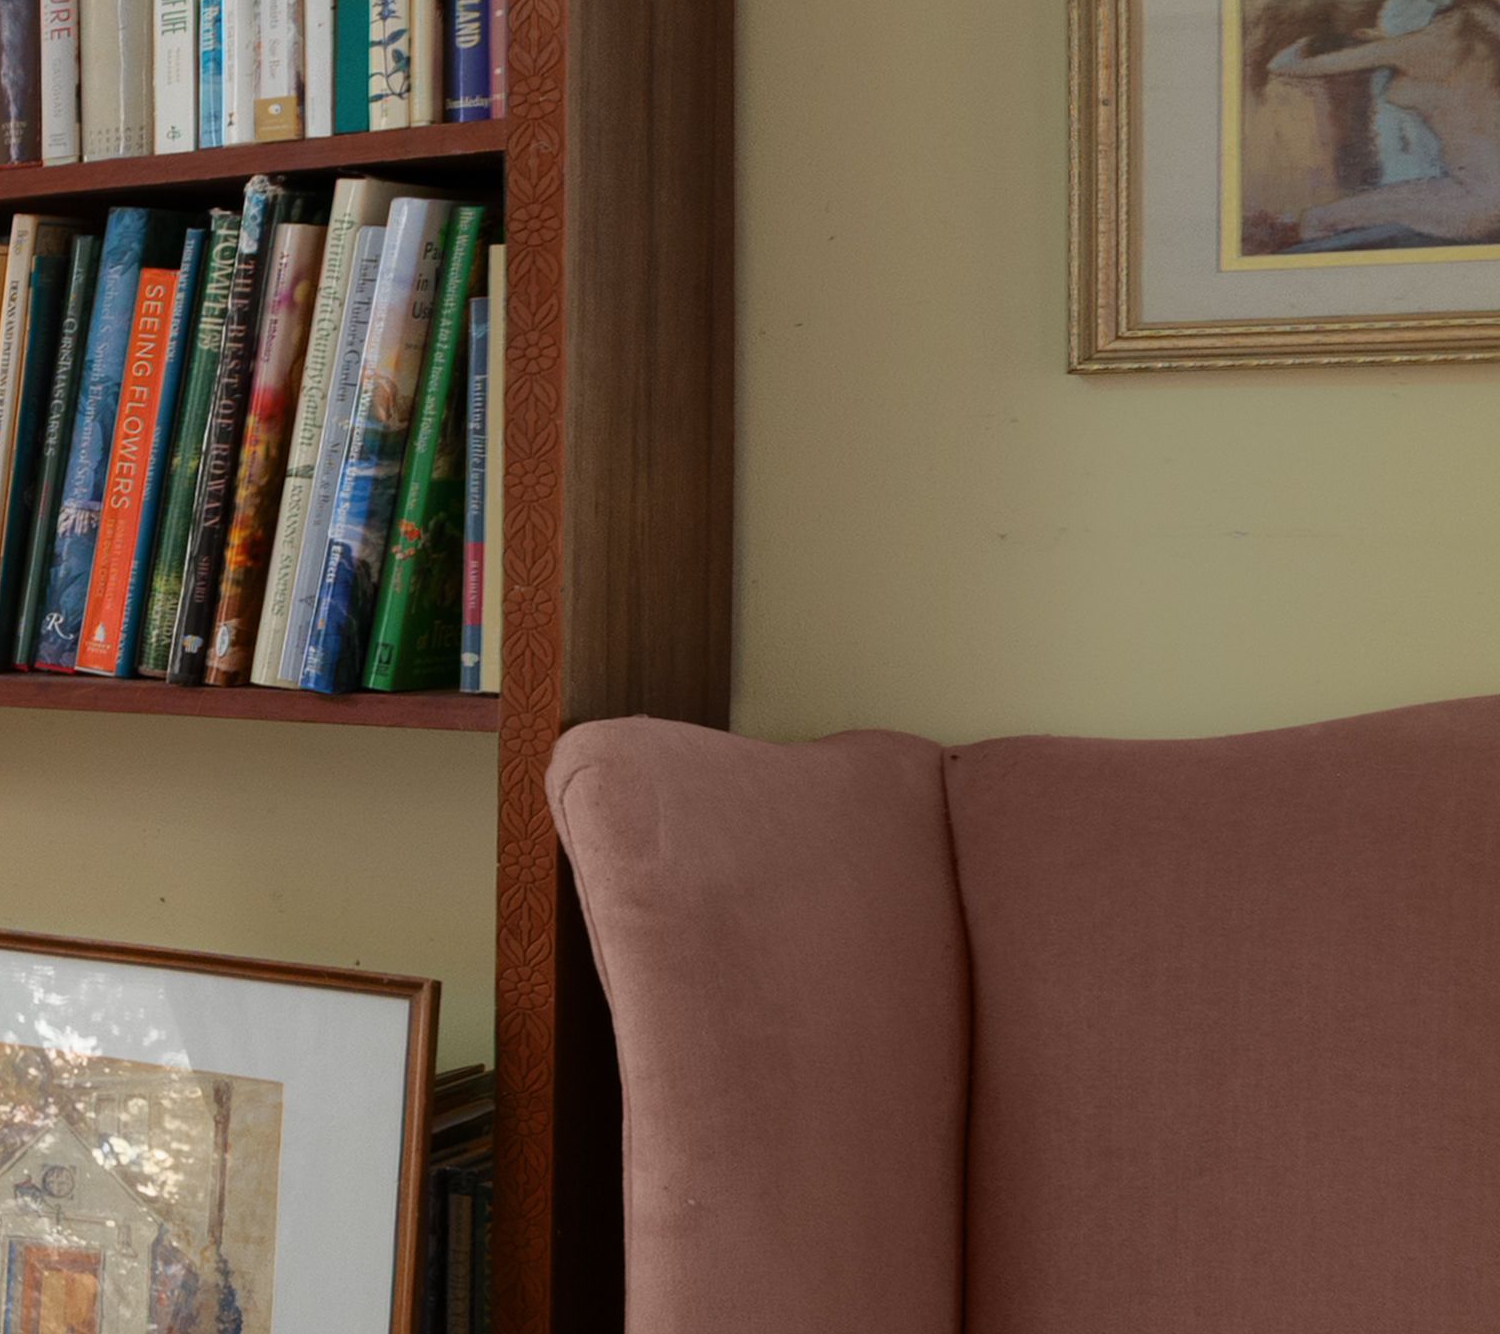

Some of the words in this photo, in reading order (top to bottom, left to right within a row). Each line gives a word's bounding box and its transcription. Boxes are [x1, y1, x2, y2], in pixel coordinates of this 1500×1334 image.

[161, 12, 187, 36] LIFE
[202, 5, 219, 51] Room
[458, 209, 475, 231] The
[182, 239, 195, 260] THIS
[179, 271, 189, 289] MY
[232, 259, 256, 311] THE
[440, 232, 470, 316] Watercolorist's
[4, 280, 21, 321] DESIGNS
[173, 291, 186, 316] WISH
[4, 321, 16, 338] AND
[132, 283, 165, 377] SEEING
[170, 317, 182, 338] FOR
[49, 317, 78, 399] CHRISTMAS
[165, 341, 178, 363] YOU
[222, 325, 246, 388] BEST
[217, 400, 239, 431] OF
[424, 395, 440, 414] and
[469, 374, 486, 430] knitting
[43, 399, 66, 457] CAROLS
[110, 385, 147, 509] FLOWERS
[470, 434, 487, 462] little
[202, 443, 231, 529] ROWAN
[468, 466, 484, 515] luxuries
[193, 555, 211, 603] SHEARD
[468, 559, 480, 609] HARDING
